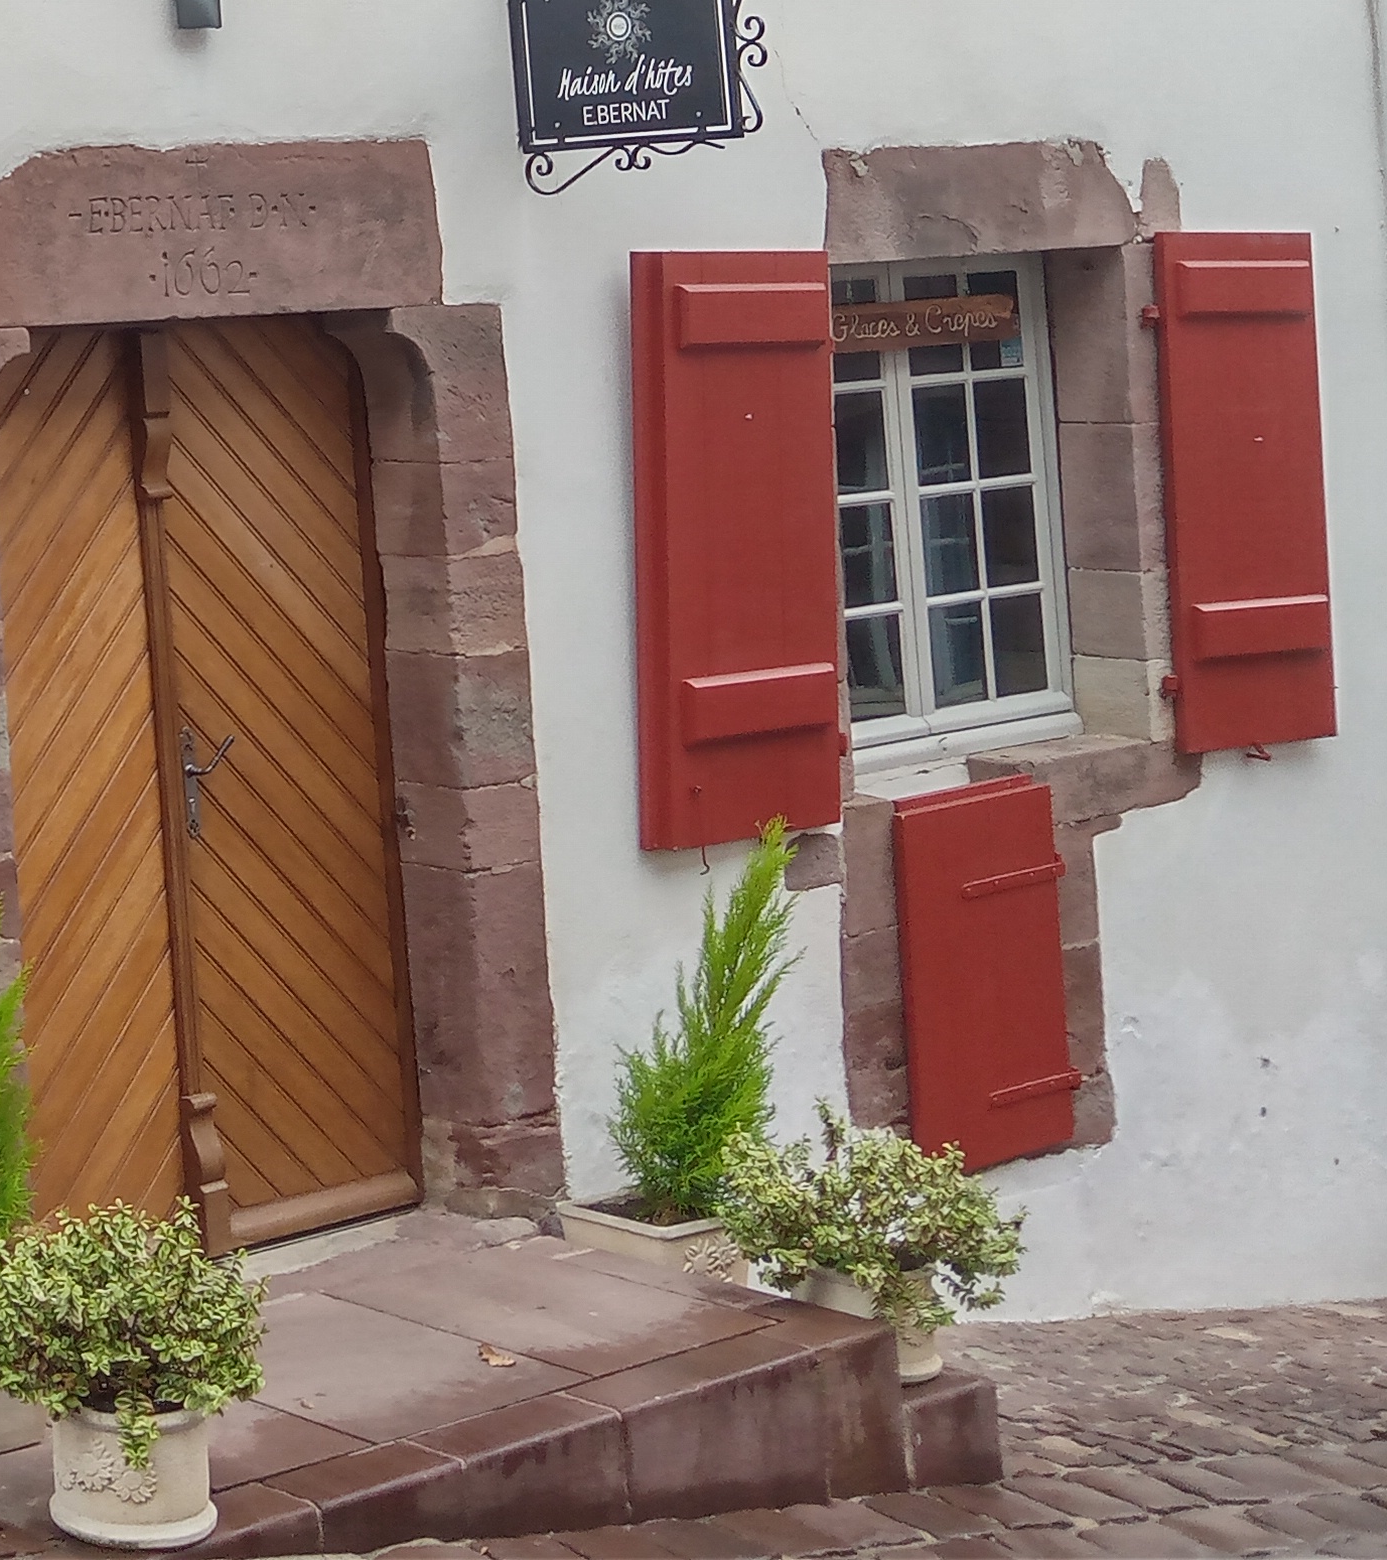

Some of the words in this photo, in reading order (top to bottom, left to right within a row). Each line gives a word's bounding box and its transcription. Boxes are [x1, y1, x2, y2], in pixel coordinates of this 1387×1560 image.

[557, 66, 621, 101] Maison
[624, 53, 693, 96] d'hôtes
[832, 313, 901, 342] Glaces
[905, 313, 921, 337] &
